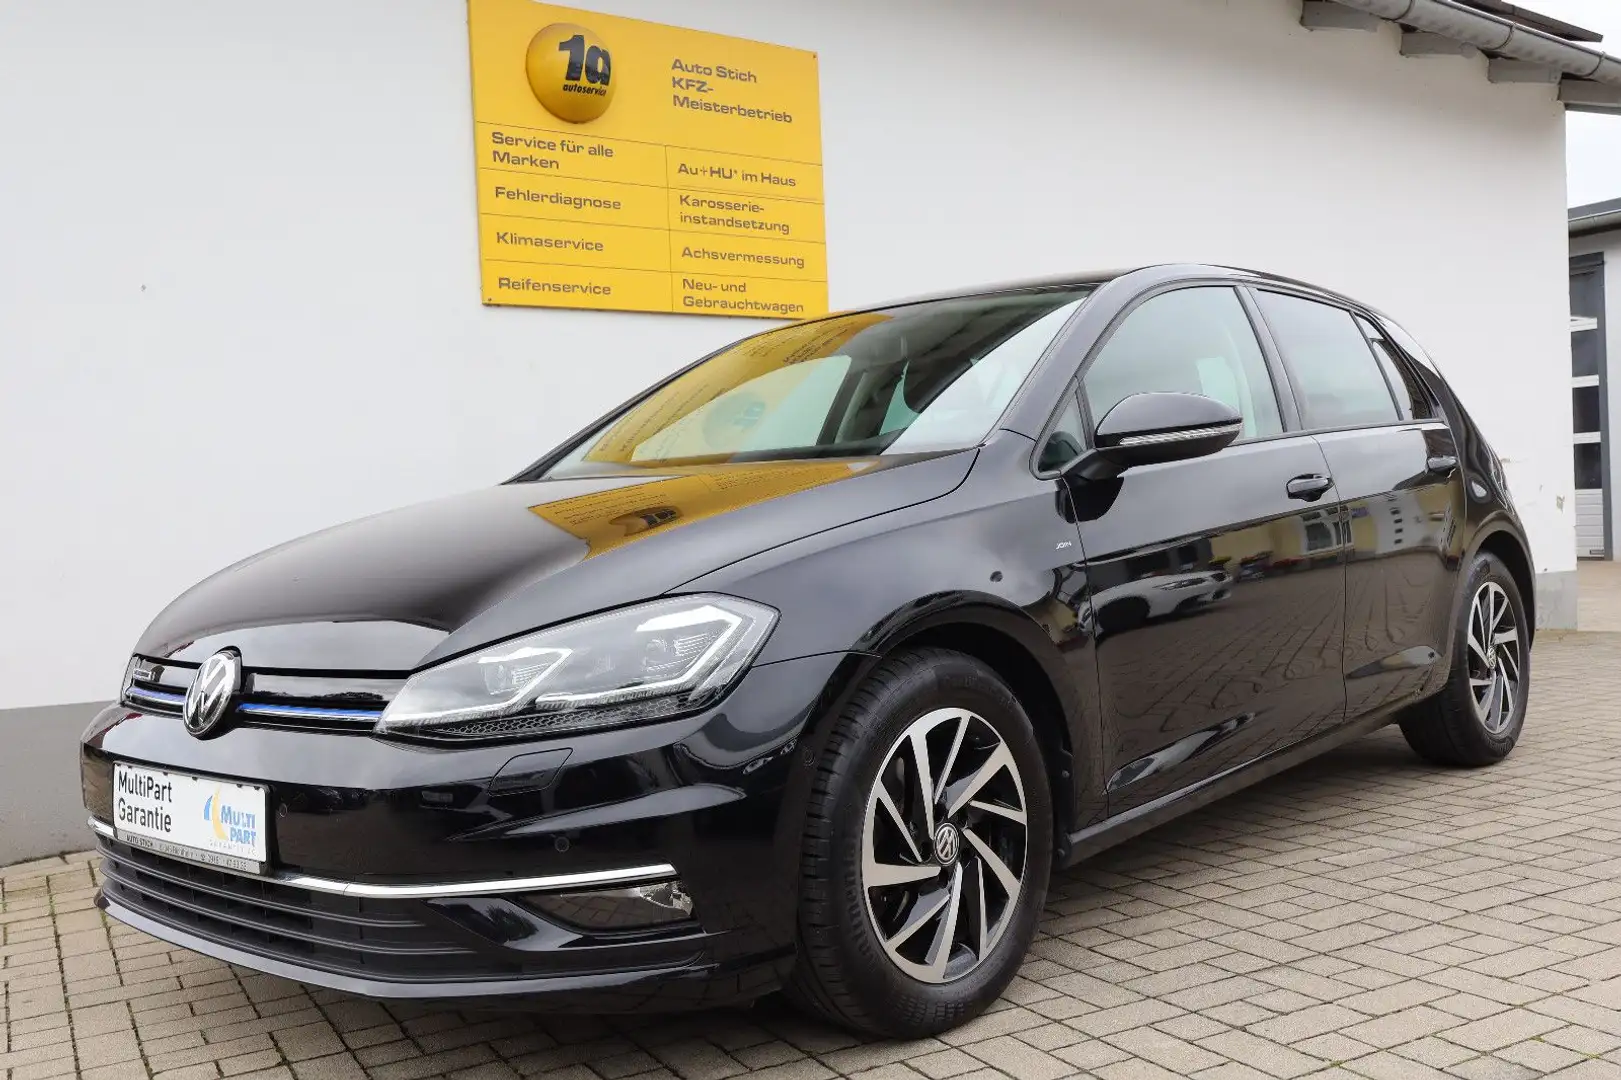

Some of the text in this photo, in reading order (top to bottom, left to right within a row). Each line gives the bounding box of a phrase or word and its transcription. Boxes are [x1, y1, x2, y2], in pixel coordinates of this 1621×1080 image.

[672, 58, 757, 82] Auto Stich
[672, 76, 714, 93] KFZ-
[673, 94, 792, 123] Meisterbetrieb
[492, 131, 614, 158] Service für alle
[492, 150, 559, 169] Marken
[742, 170, 758, 182] im
[761, 172, 796, 187] Haus
[495, 186, 621, 210] Fehlerdiagnose
[680, 194, 764, 213] Karosserie-
[680, 212, 790, 235] instandsetzung
[496, 232, 604, 252] Klimaservice
[682, 246, 804, 268] Achsvermessung
[498, 277, 611, 295] Reifenservice
[682, 278, 746, 292] Neu- und
[682, 296, 804, 314] Gebrauchtwagen
[118, 770, 172, 803] MultiPart
[118, 798, 172, 832] Garantie
[230, 826, 256, 847] PART
